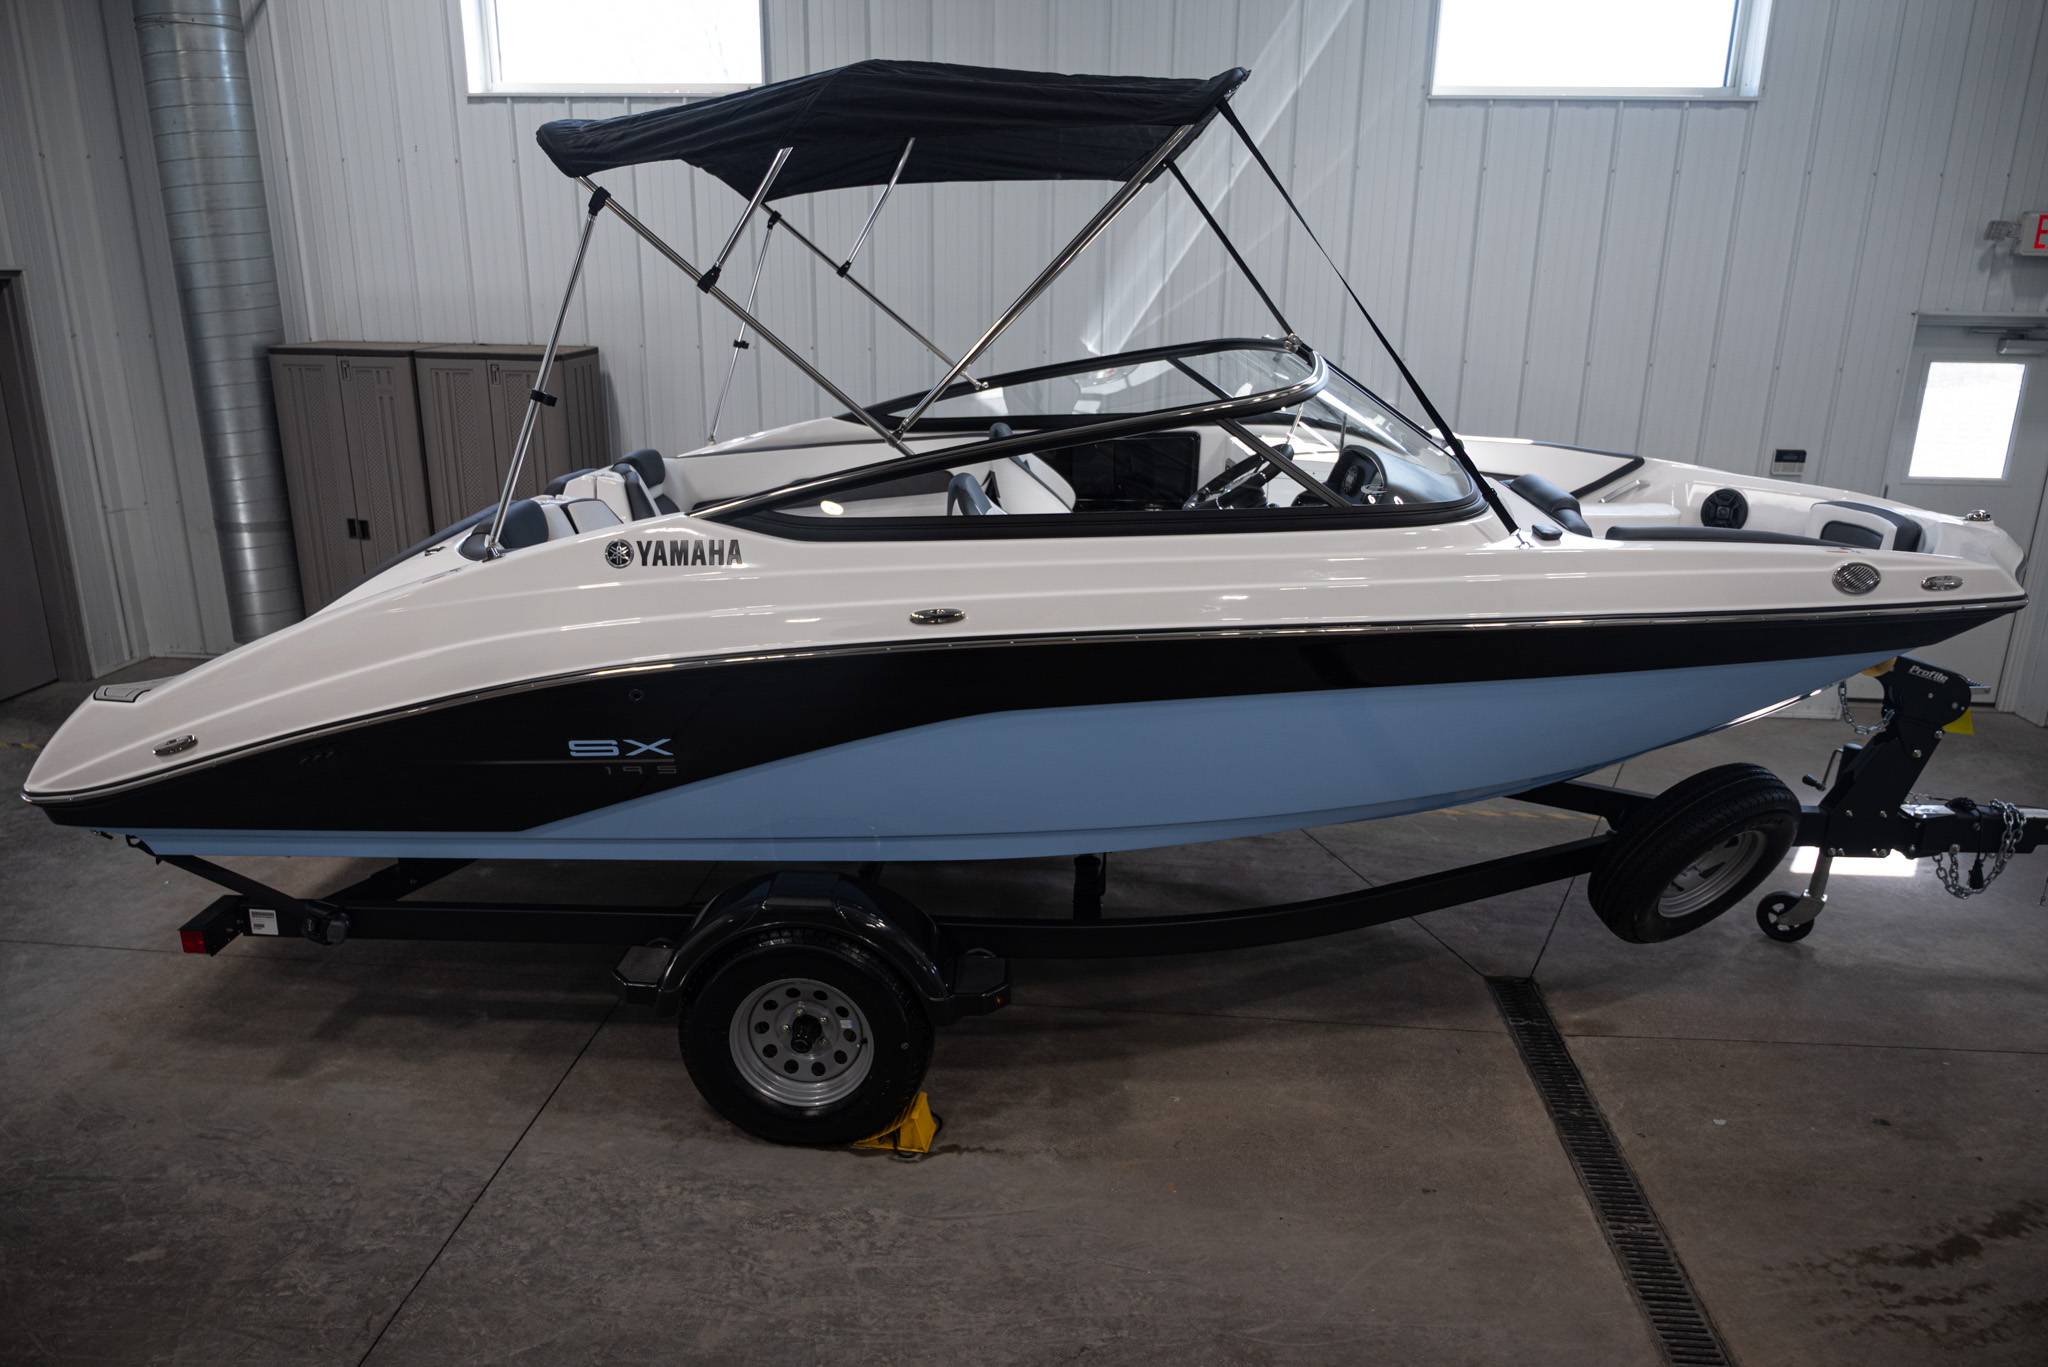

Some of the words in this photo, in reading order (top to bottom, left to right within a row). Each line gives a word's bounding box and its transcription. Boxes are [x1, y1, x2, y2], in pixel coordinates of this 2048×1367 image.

[636, 539, 743, 566] YAMAHA
[1909, 665, 1949, 681] Profile
[568, 738, 674, 757] SX
